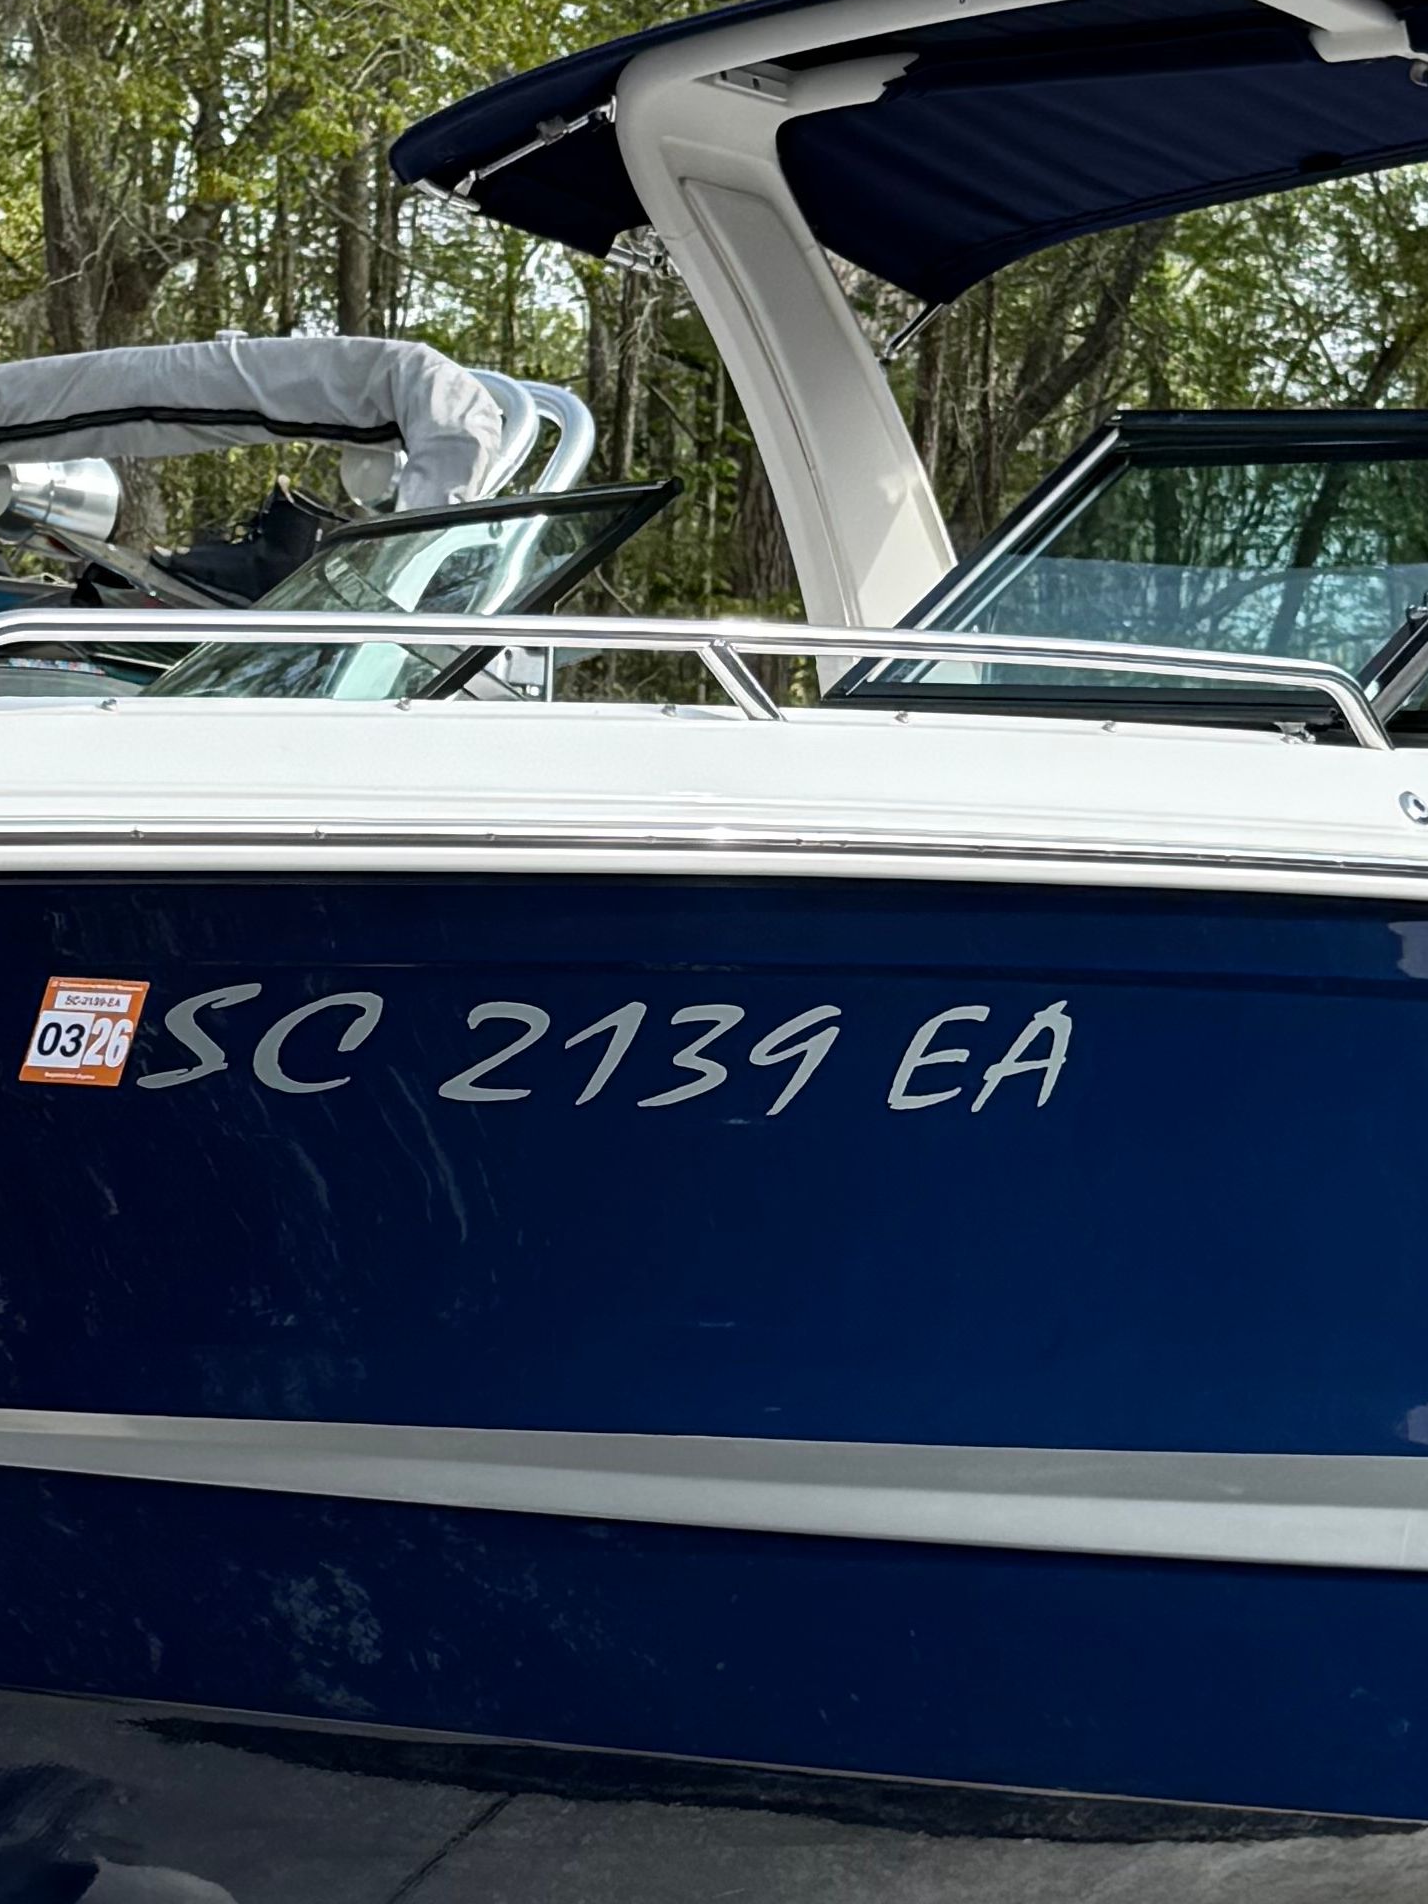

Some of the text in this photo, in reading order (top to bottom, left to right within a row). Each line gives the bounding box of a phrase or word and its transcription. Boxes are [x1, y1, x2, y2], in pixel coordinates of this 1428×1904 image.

[37, 1017, 134, 1068] 03 26
[137, 982, 1073, 1116] SC 2139 EA
